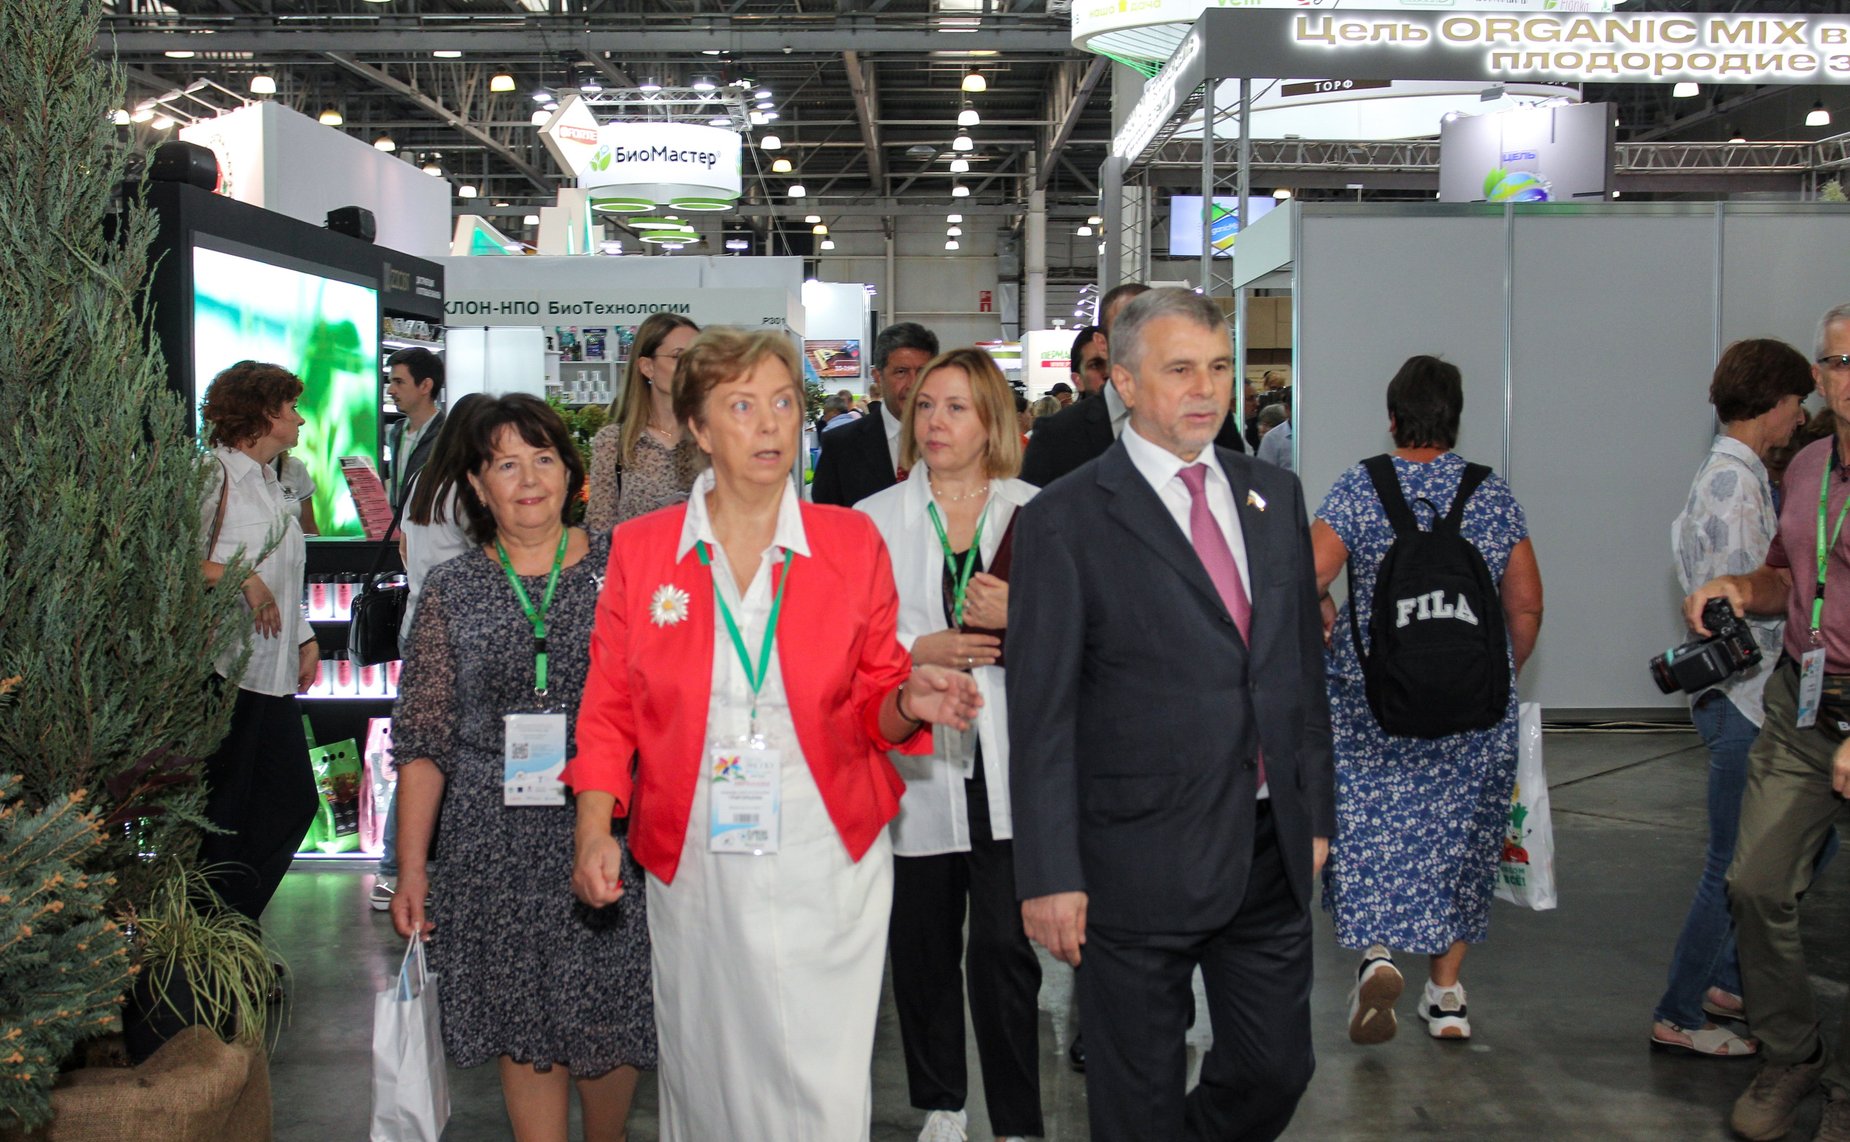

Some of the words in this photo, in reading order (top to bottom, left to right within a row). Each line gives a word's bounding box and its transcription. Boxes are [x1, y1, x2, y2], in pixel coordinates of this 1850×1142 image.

[1296, 16, 1429, 45] Цель
[1442, 17, 1697, 43] ORGANIC
[1711, 20, 1807, 44] MIX
[1492, 51, 1817, 76] плодородие
[1314, 79, 1354, 92] ТОРФ
[1503, 152, 1537, 162] ЦЕЛЬ
[548, 301, 691, 315] БиоТехнологии
[1396, 590, 1479, 628] FILA
